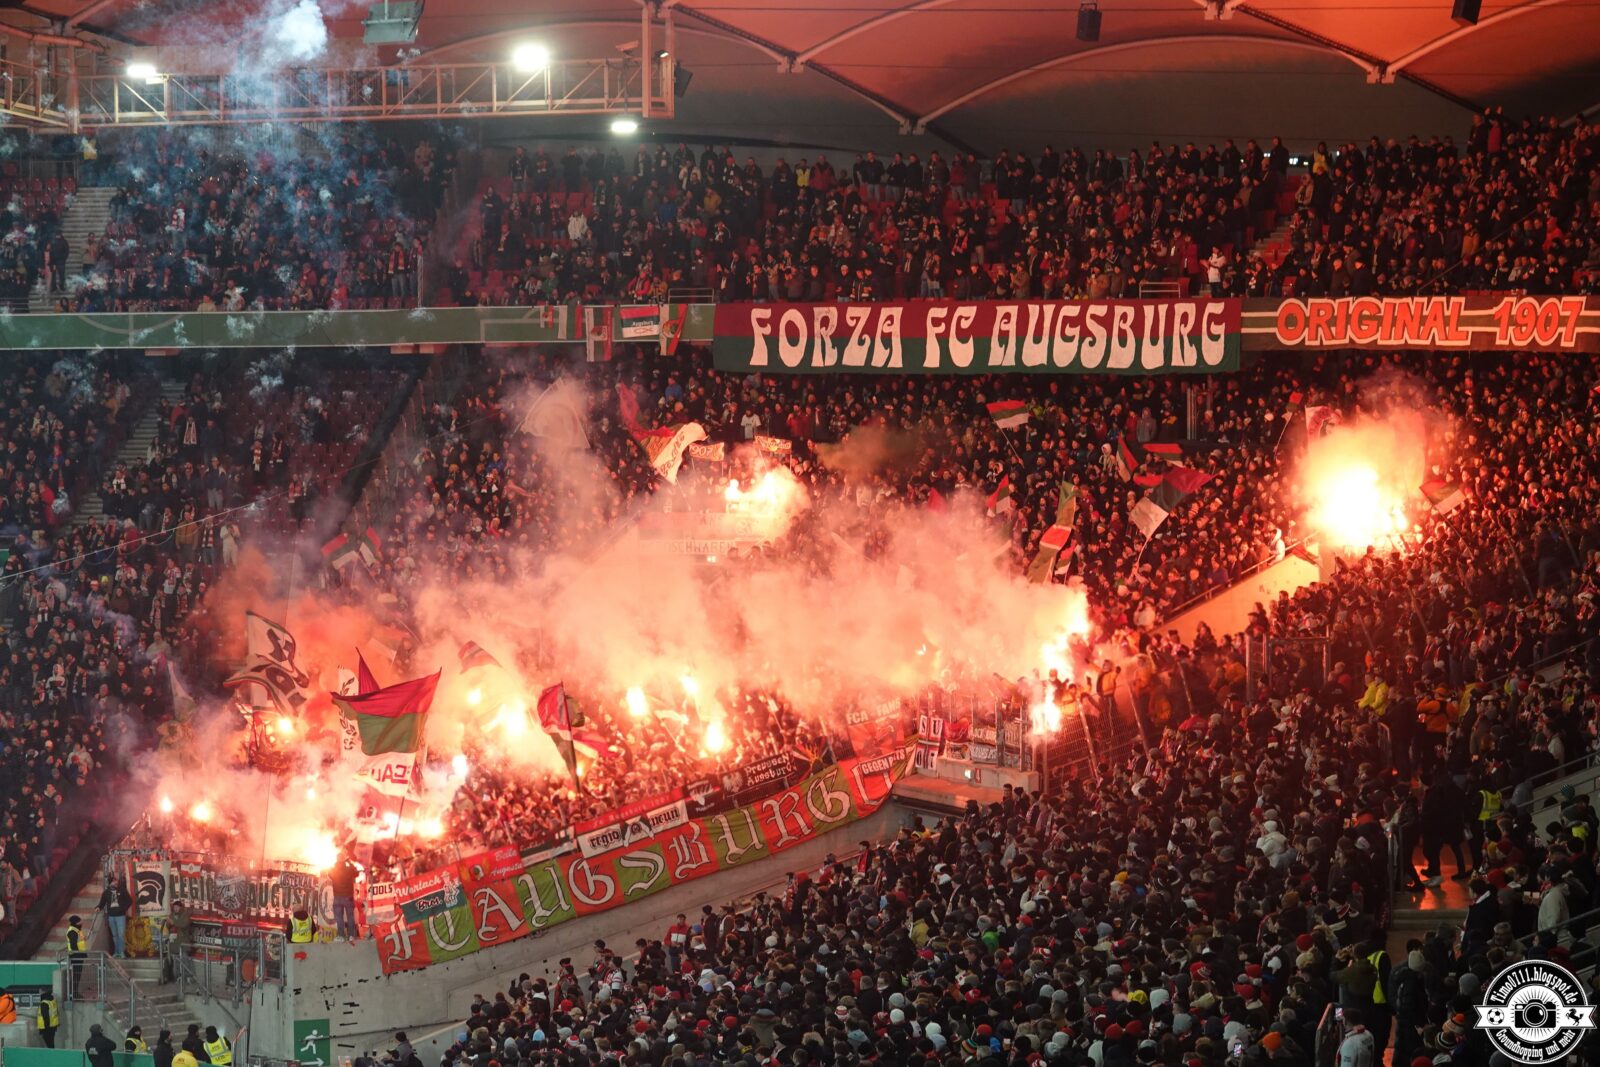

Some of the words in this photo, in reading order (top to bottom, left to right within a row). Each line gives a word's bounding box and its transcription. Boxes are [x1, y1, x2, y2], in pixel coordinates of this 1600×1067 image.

[749, 306, 903, 368] FORZA
[923, 305, 977, 368] FC
[988, 302, 1225, 368] AUGSBURG
[1275, 297, 1472, 346] ORIGINAL
[1494, 296, 1587, 347] 1907
[861, 757, 890, 775] GEGEN
[473, 766, 851, 942] AUGSBURG
